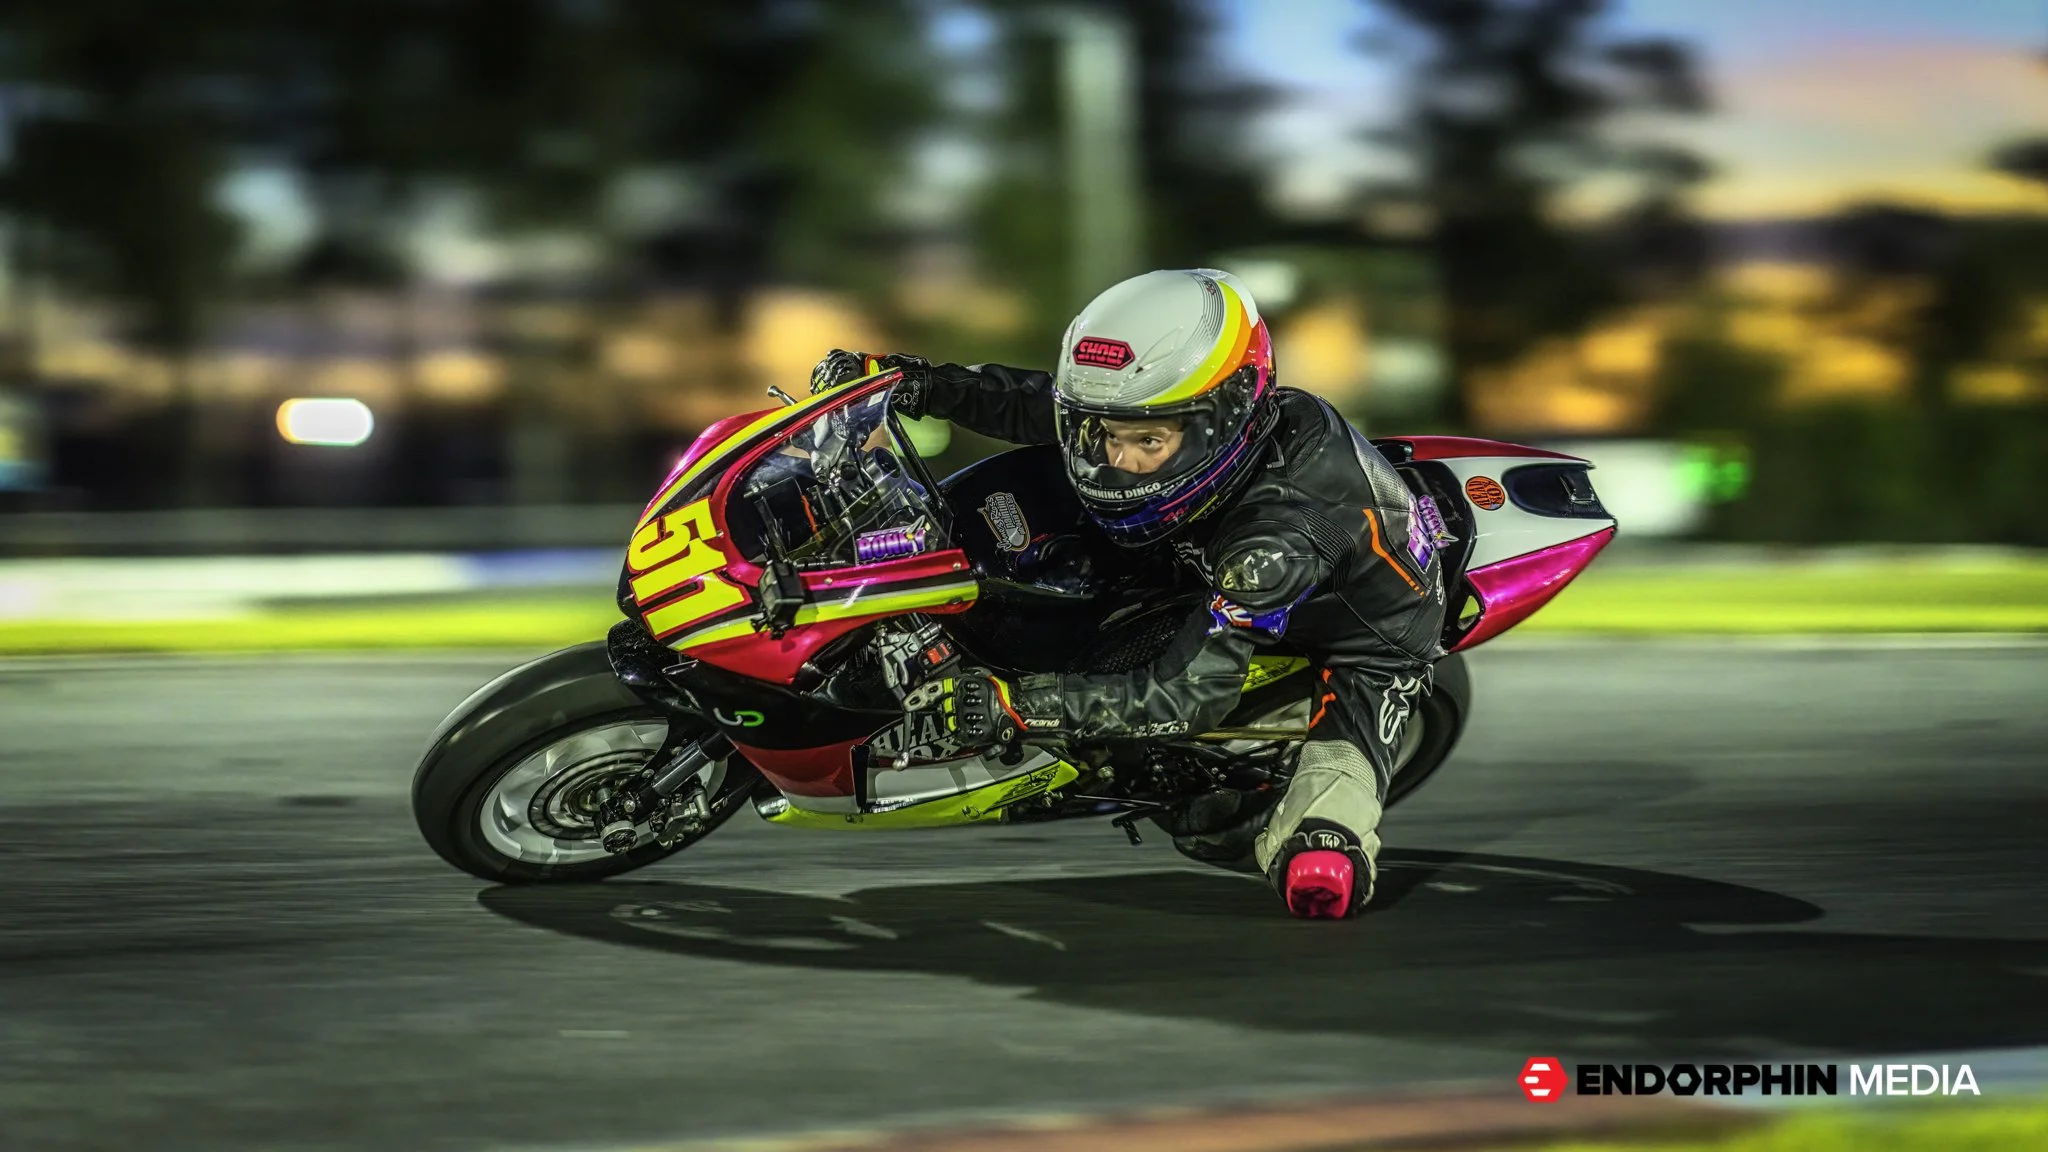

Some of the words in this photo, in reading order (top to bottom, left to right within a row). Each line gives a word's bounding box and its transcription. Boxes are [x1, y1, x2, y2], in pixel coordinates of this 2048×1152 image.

[1077, 341, 1126, 366] SHOEI
[1078, 483, 1123, 499] GRINNING
[1124, 482, 1162, 499] DINGO
[986, 496, 1000, 521] Ross
[628, 497, 745, 637] 511
